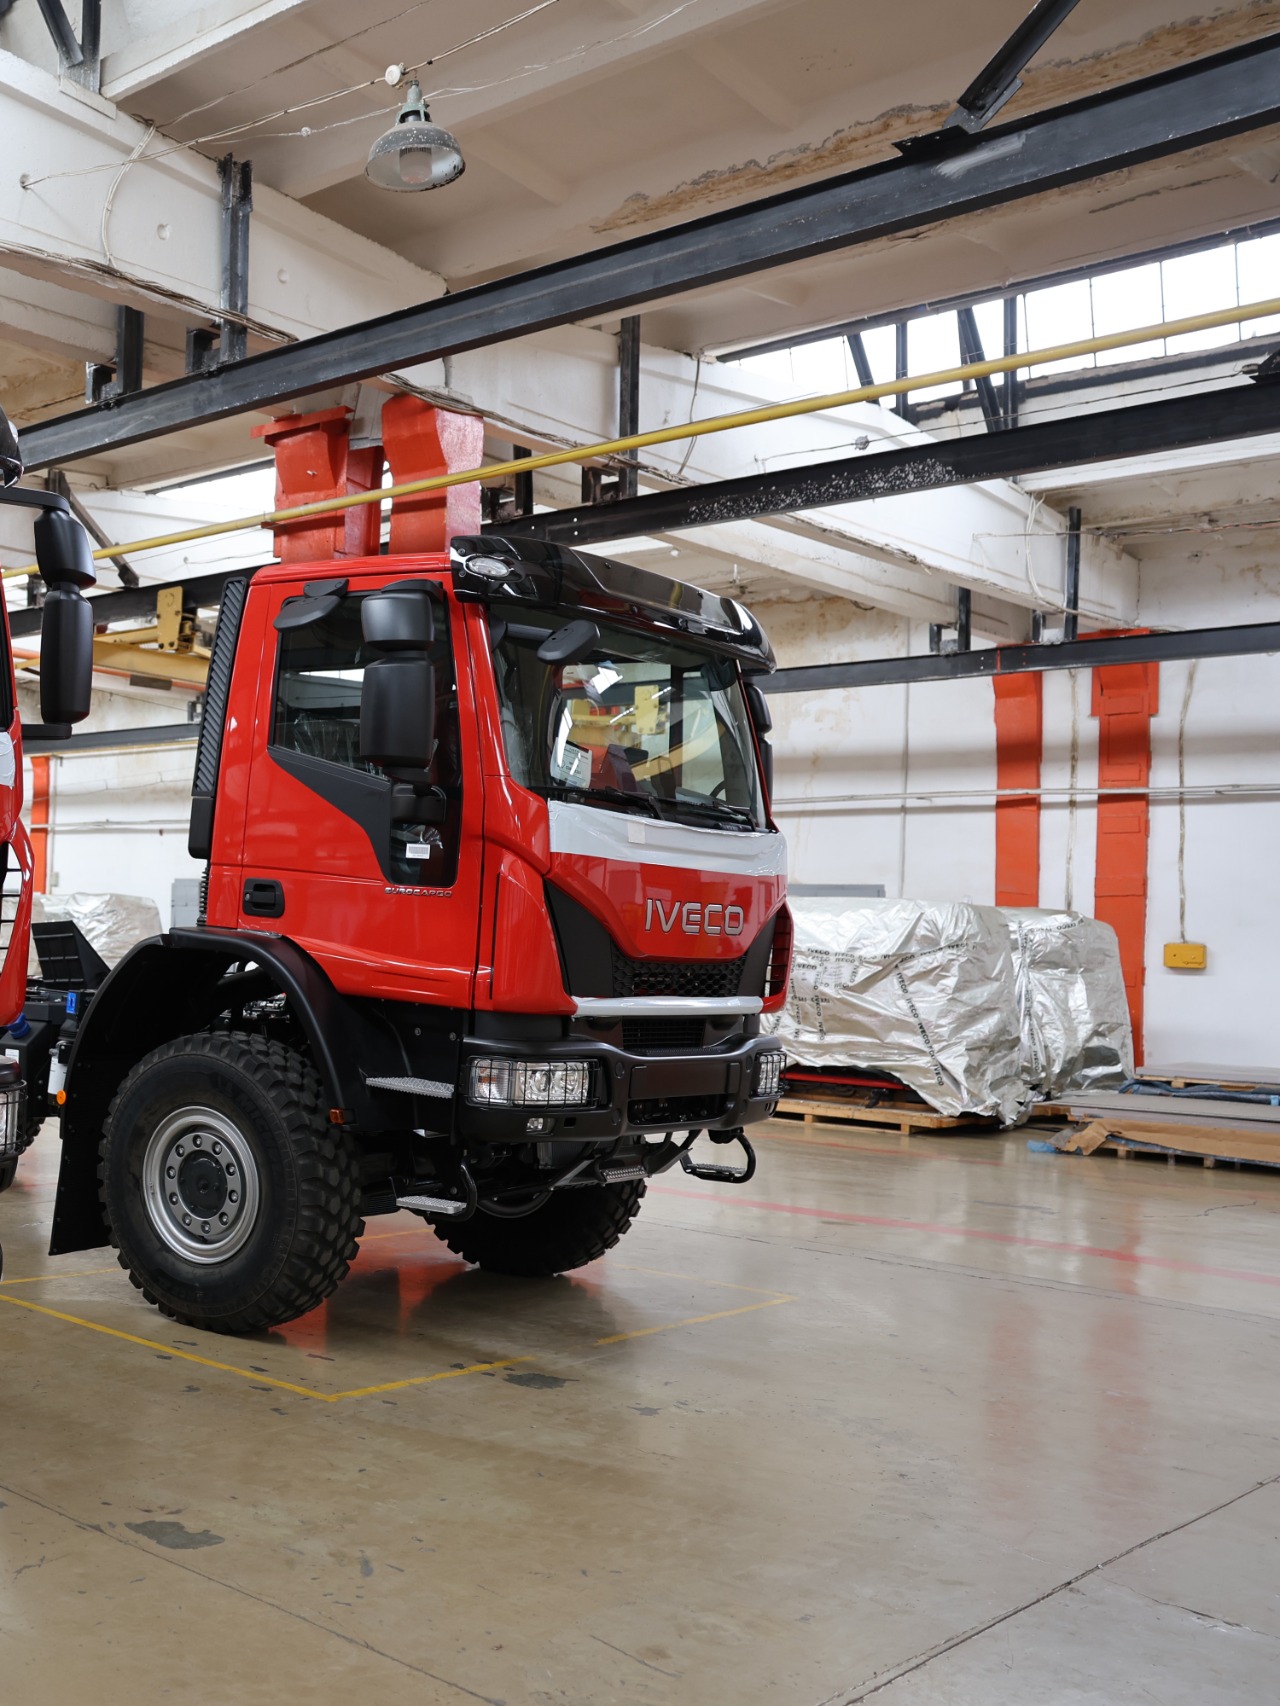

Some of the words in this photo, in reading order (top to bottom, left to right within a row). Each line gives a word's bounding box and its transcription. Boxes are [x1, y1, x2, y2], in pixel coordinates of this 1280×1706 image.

[384, 886, 453, 897] EUROCARGO
[645, 898, 744, 936] IVECO
[897, 972, 909, 994] IVECO
[906, 998, 919, 1019] IVECO
[918, 1022, 931, 1044] IVECO
[934, 1064, 945, 1086] IVECO
